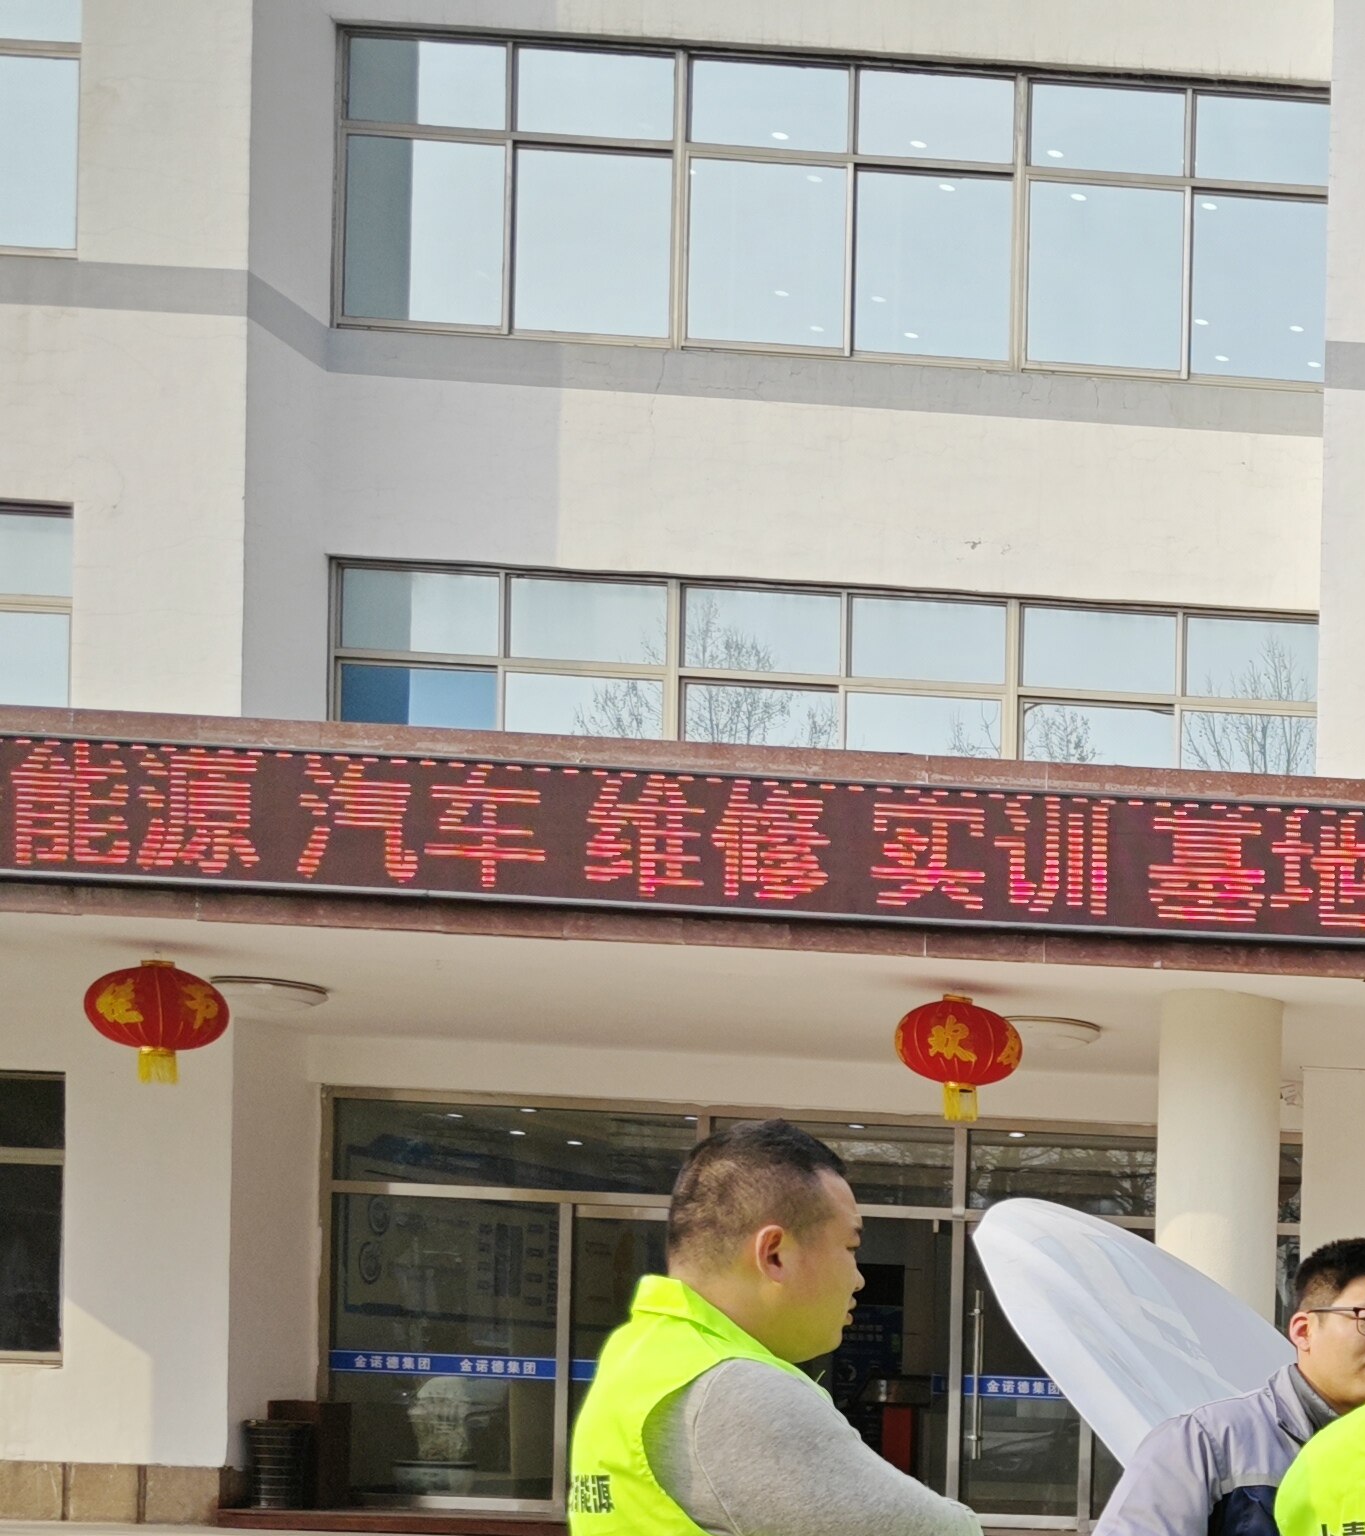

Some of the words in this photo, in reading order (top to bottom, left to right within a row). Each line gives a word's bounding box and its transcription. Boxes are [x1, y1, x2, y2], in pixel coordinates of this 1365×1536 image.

[353, 1354, 431, 1371] 金诺德集团
[459, 1357, 537, 1375] 金诺德集团
[570, 1474, 616, 1514] 能源
